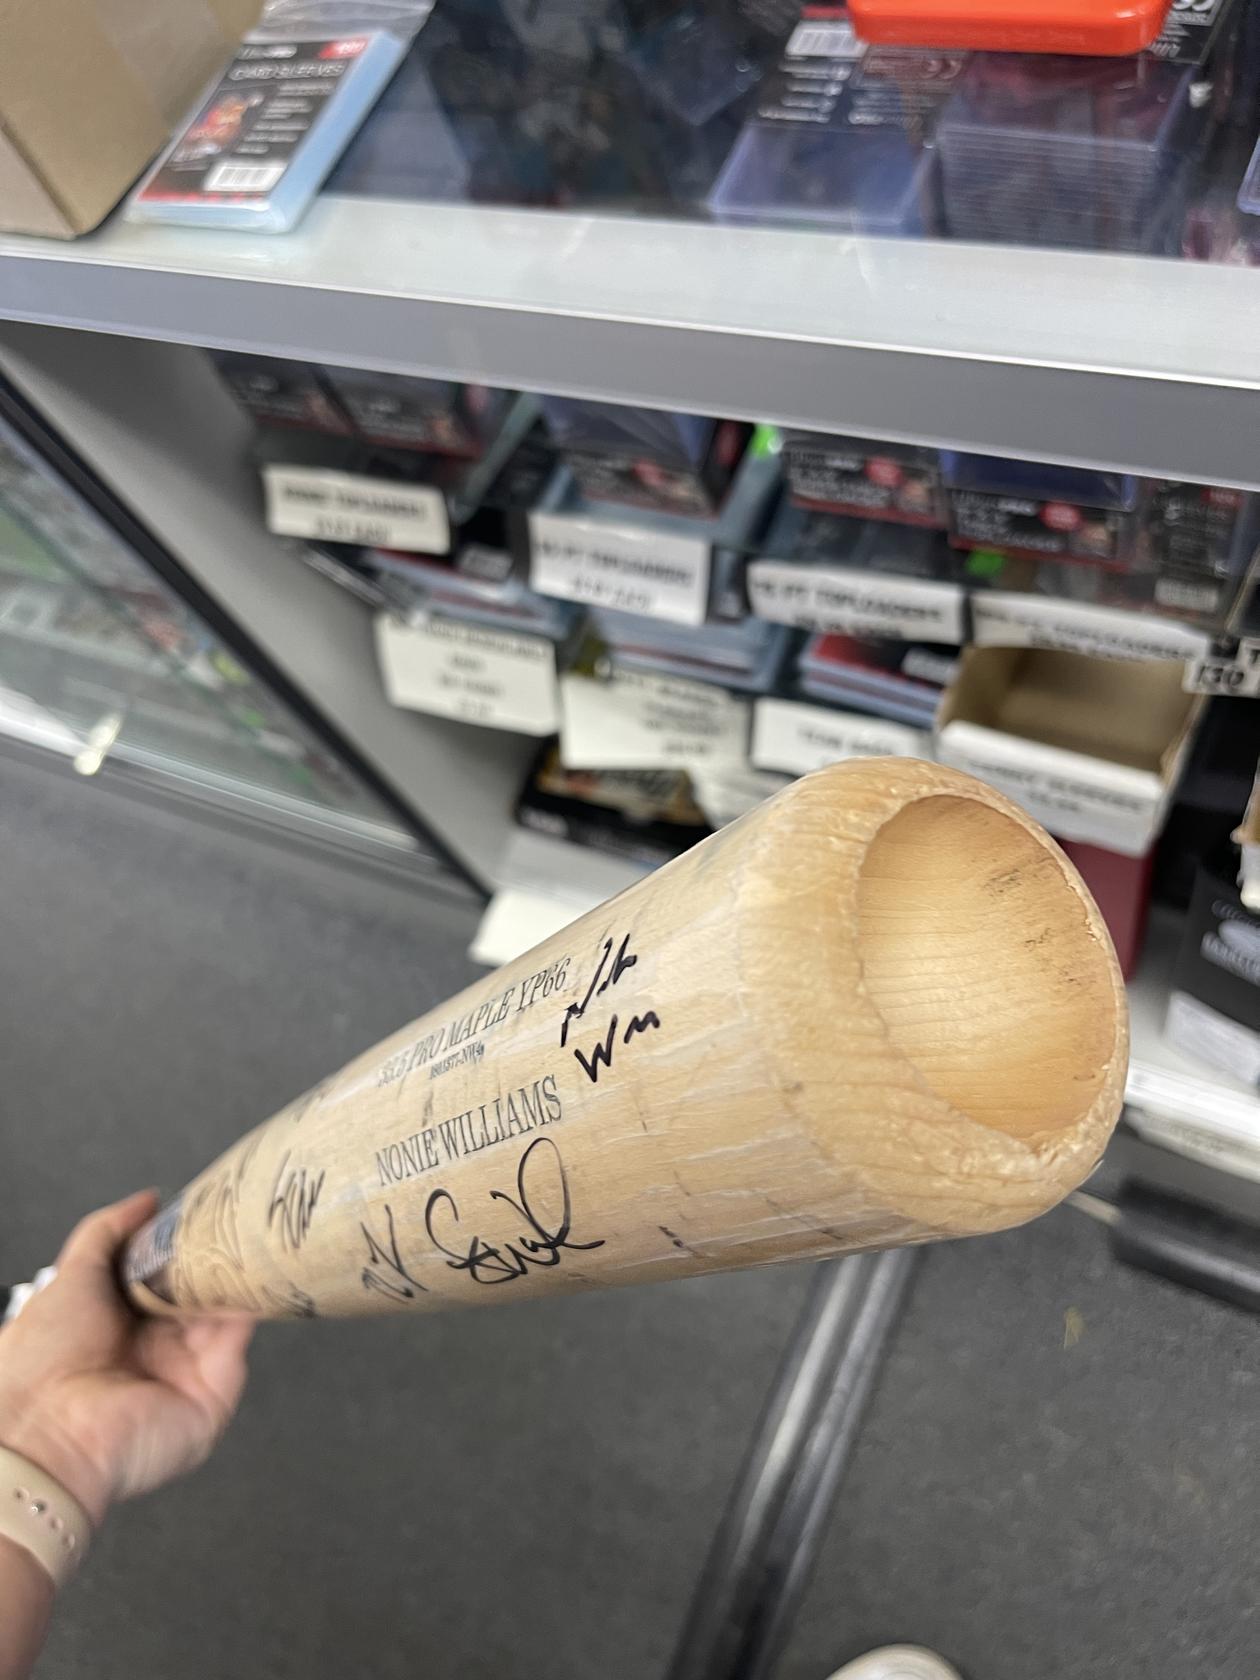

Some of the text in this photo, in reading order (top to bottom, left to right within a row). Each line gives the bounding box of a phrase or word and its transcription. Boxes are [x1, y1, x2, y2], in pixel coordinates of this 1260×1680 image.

[443, 986, 517, 1052] MAPLE
[515, 956, 572, 1013] YP66
[374, 1073, 563, 1187] NONIE WILLIAMS
